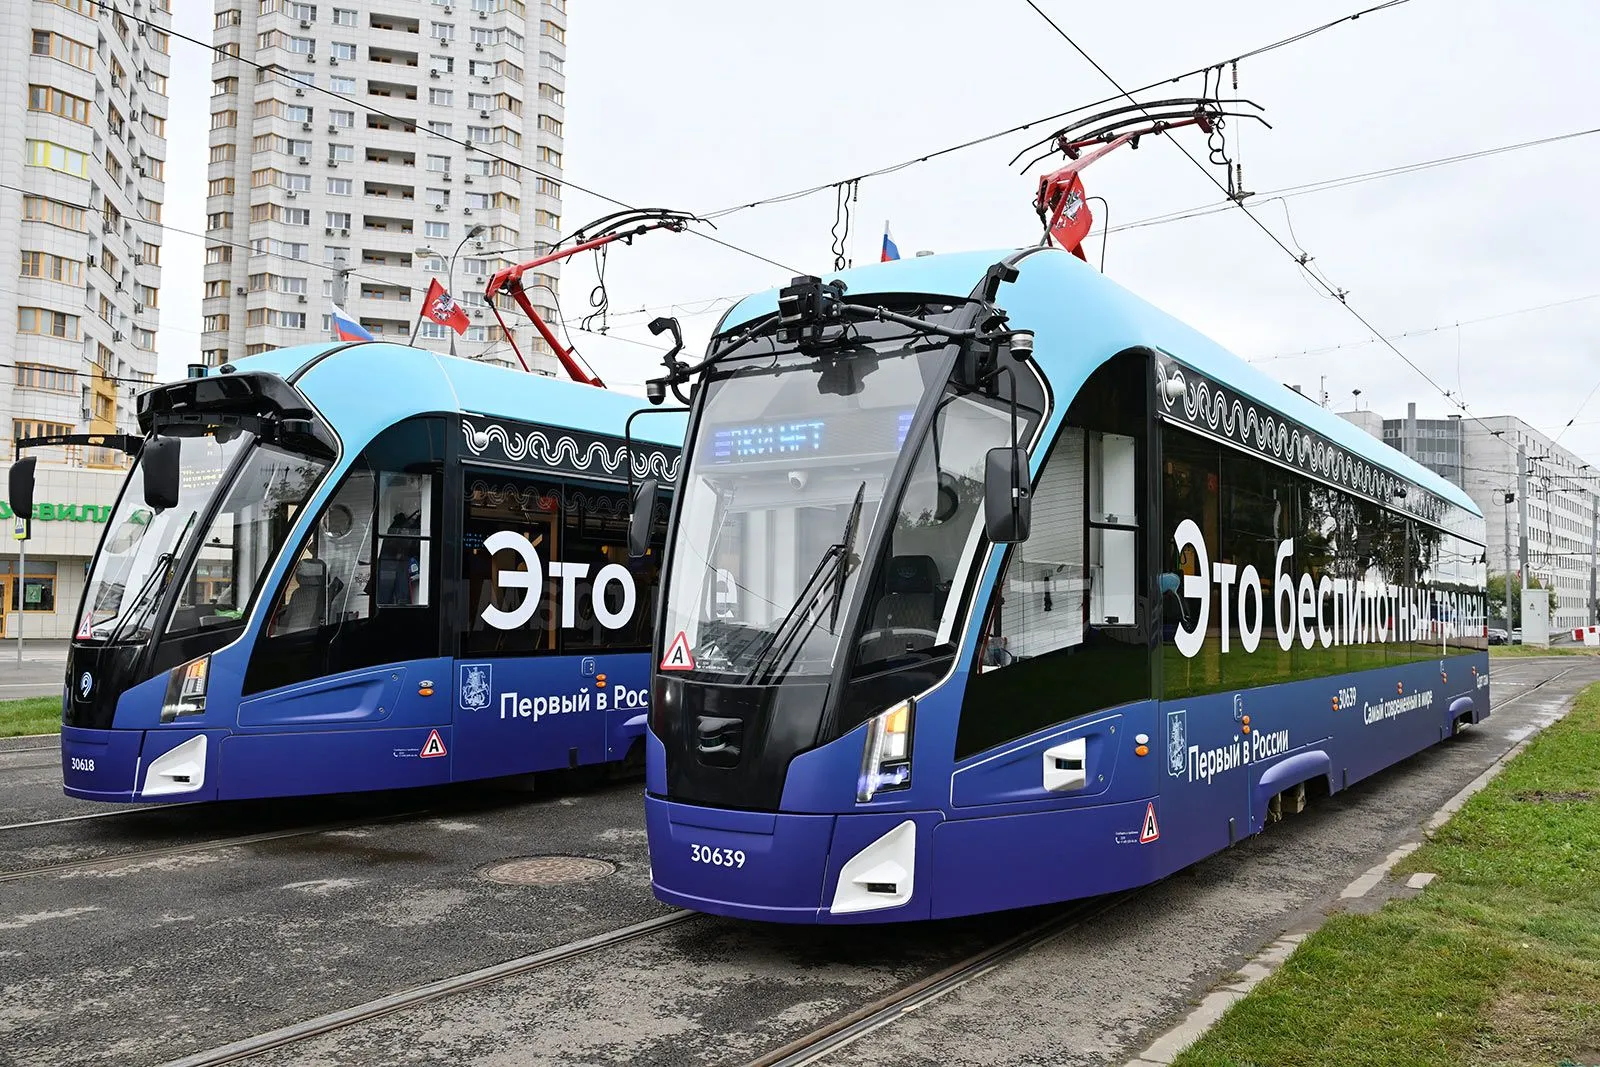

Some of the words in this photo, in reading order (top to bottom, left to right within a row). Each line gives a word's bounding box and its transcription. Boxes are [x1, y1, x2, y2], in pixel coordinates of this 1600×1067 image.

[480, 530, 636, 630] Это
[1174, 519, 1263, 658] Это
[1274, 537, 1432, 652] беспилотный
[500, 688, 590, 722] Первый
[596, 691, 608, 711] в
[71, 757, 95, 772] 30618
[1188, 734, 1240, 785] Первый
[1243, 740, 1250, 764] в
[1252, 729, 1289, 761] России
[690, 843, 746, 869] 30639
